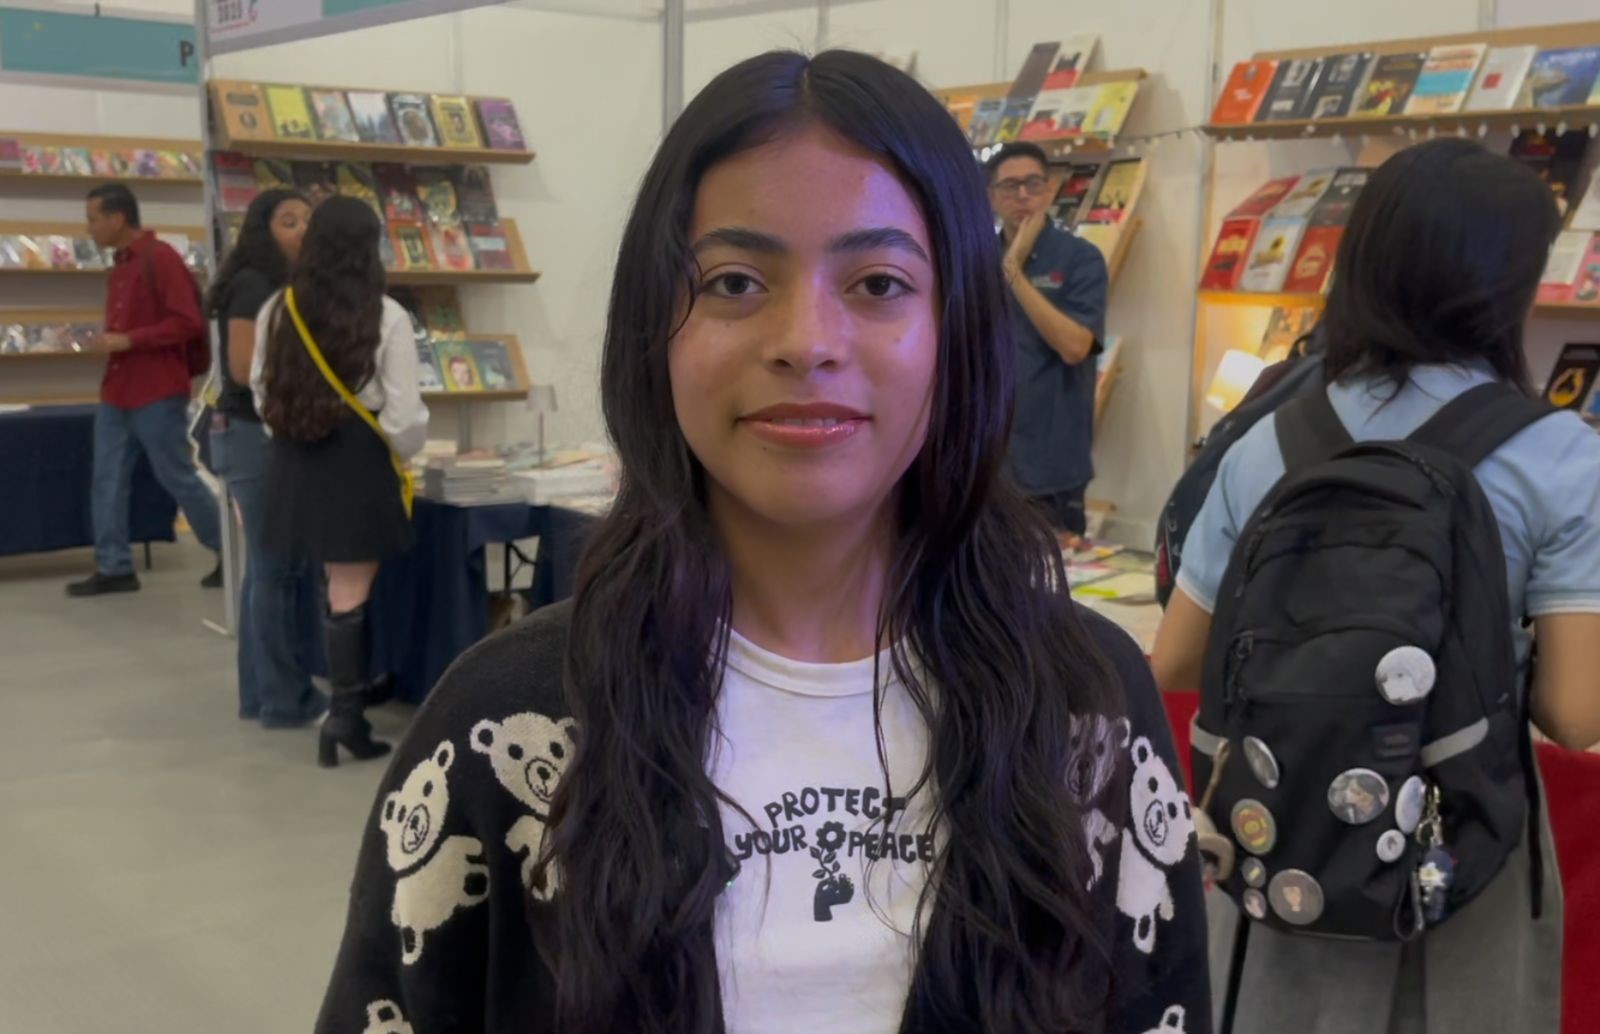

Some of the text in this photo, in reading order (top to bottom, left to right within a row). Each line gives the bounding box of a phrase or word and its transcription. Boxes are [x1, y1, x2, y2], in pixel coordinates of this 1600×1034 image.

[764, 786, 906, 828] PROTECT
[735, 824, 935, 864] YOUR PEACE
